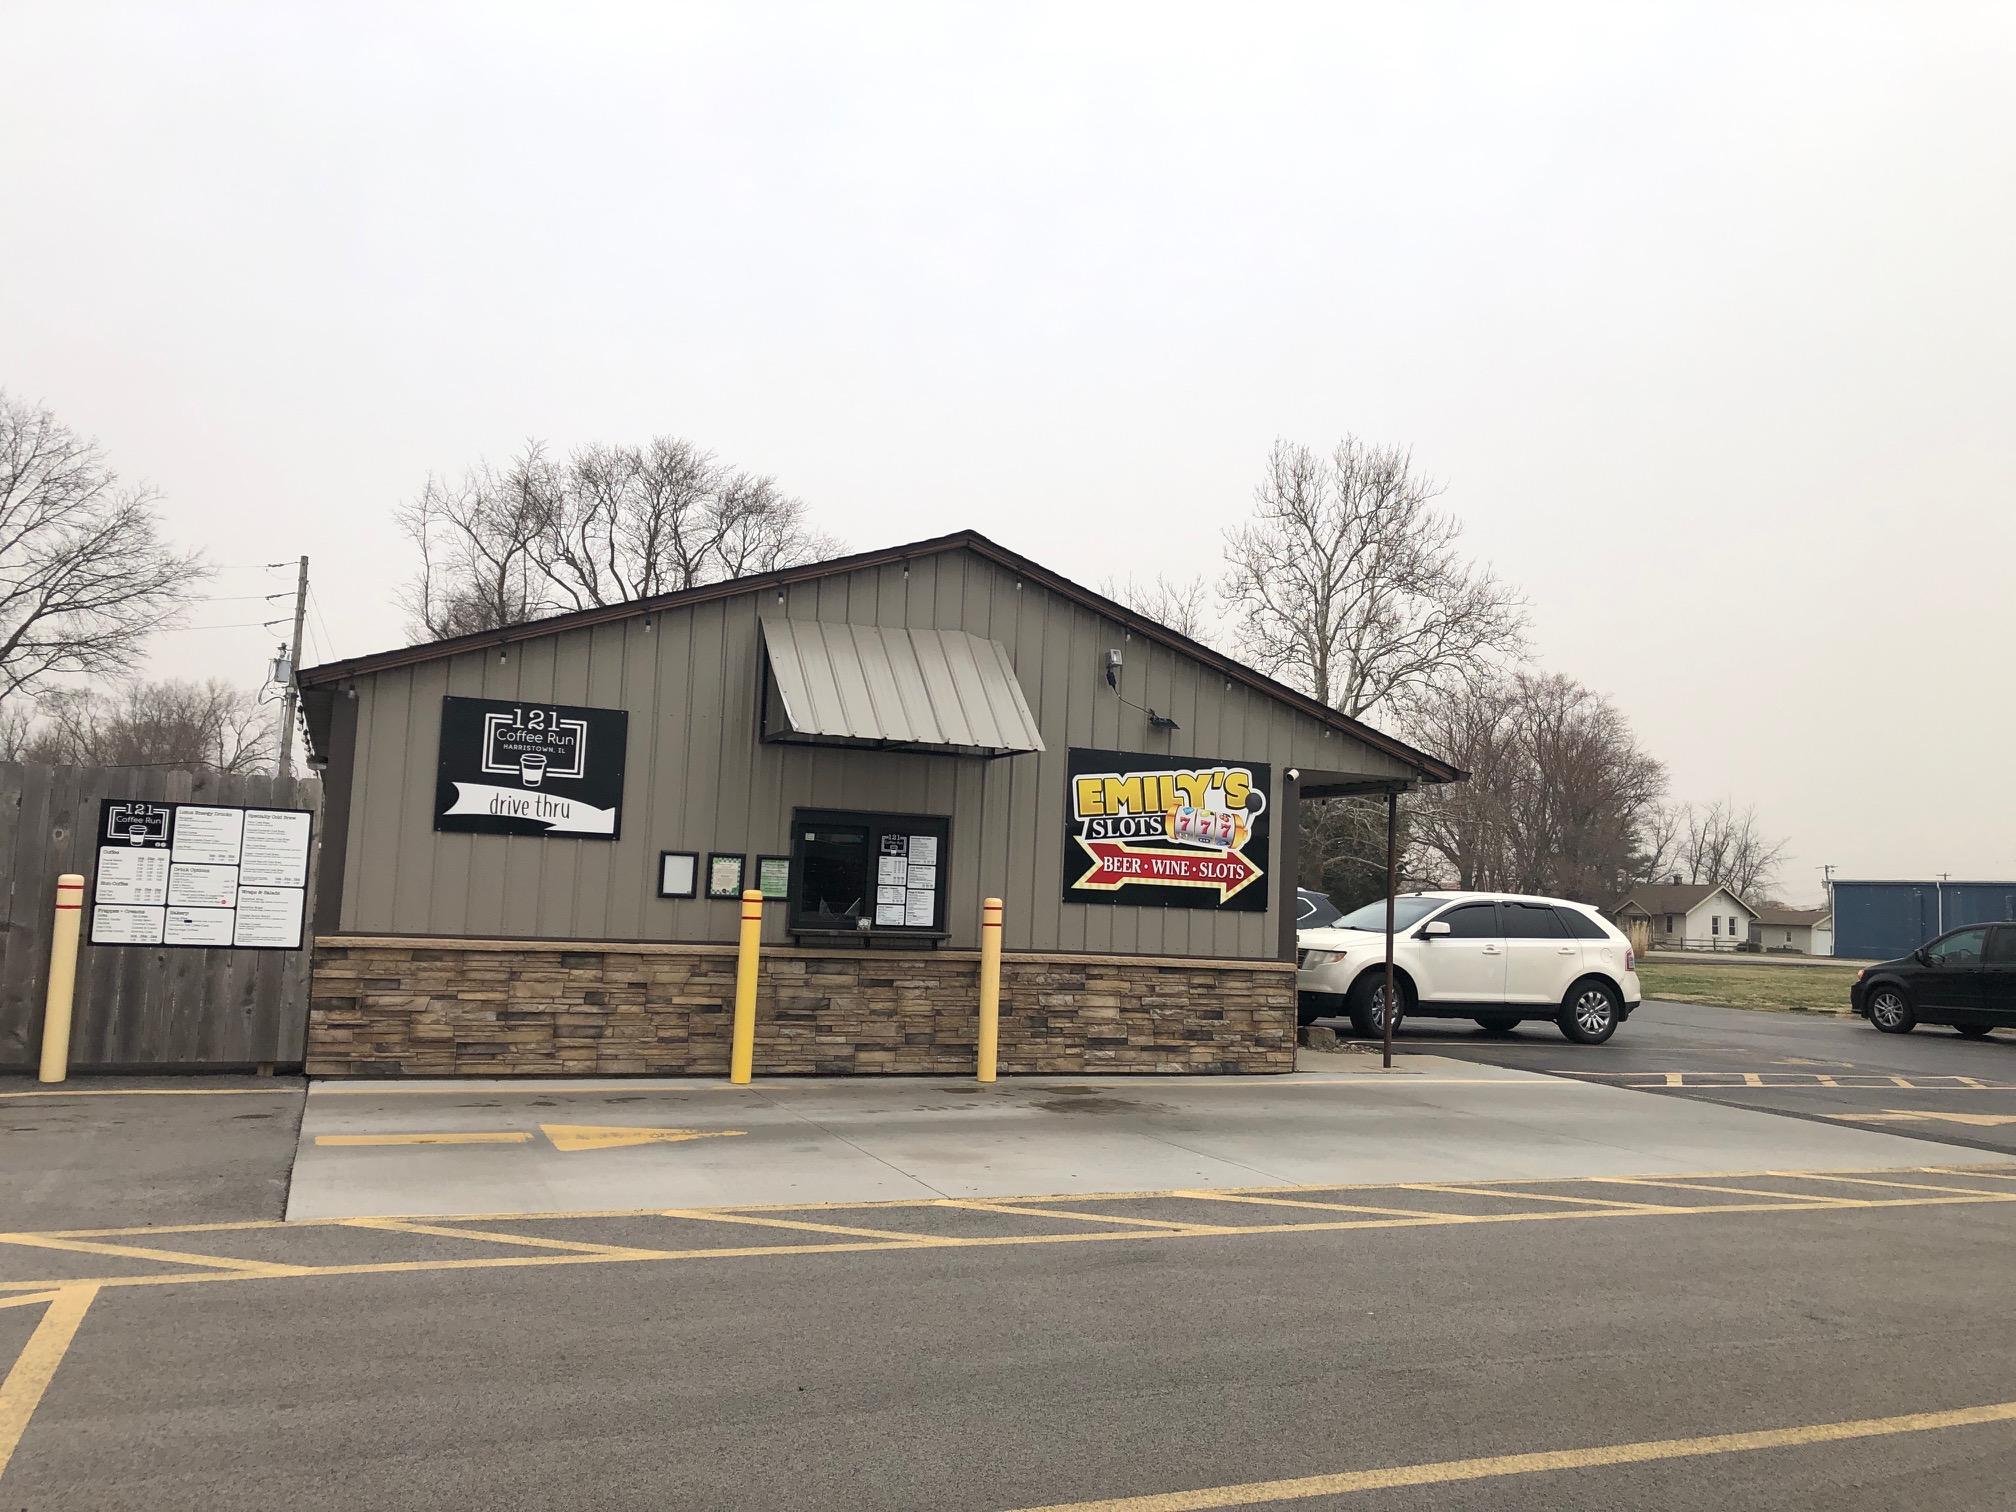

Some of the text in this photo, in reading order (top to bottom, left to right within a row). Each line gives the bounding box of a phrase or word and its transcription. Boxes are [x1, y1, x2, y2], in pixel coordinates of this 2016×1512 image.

[512, 708, 560, 731] 121
[496, 728, 574, 746] Coffee Run
[503, 743, 556, 754] HARRISTOWN,
[1076, 771, 1251, 818] EMILY'S
[125, 803, 154, 816] 121
[489, 792, 571, 819] drive thru
[116, 815, 162, 825] Coffee Run
[1092, 817, 1163, 838] SLOTS
[1180, 816, 1232, 838] 7 7 7
[1103, 856, 1246, 880] BEER WINE SLOTS
